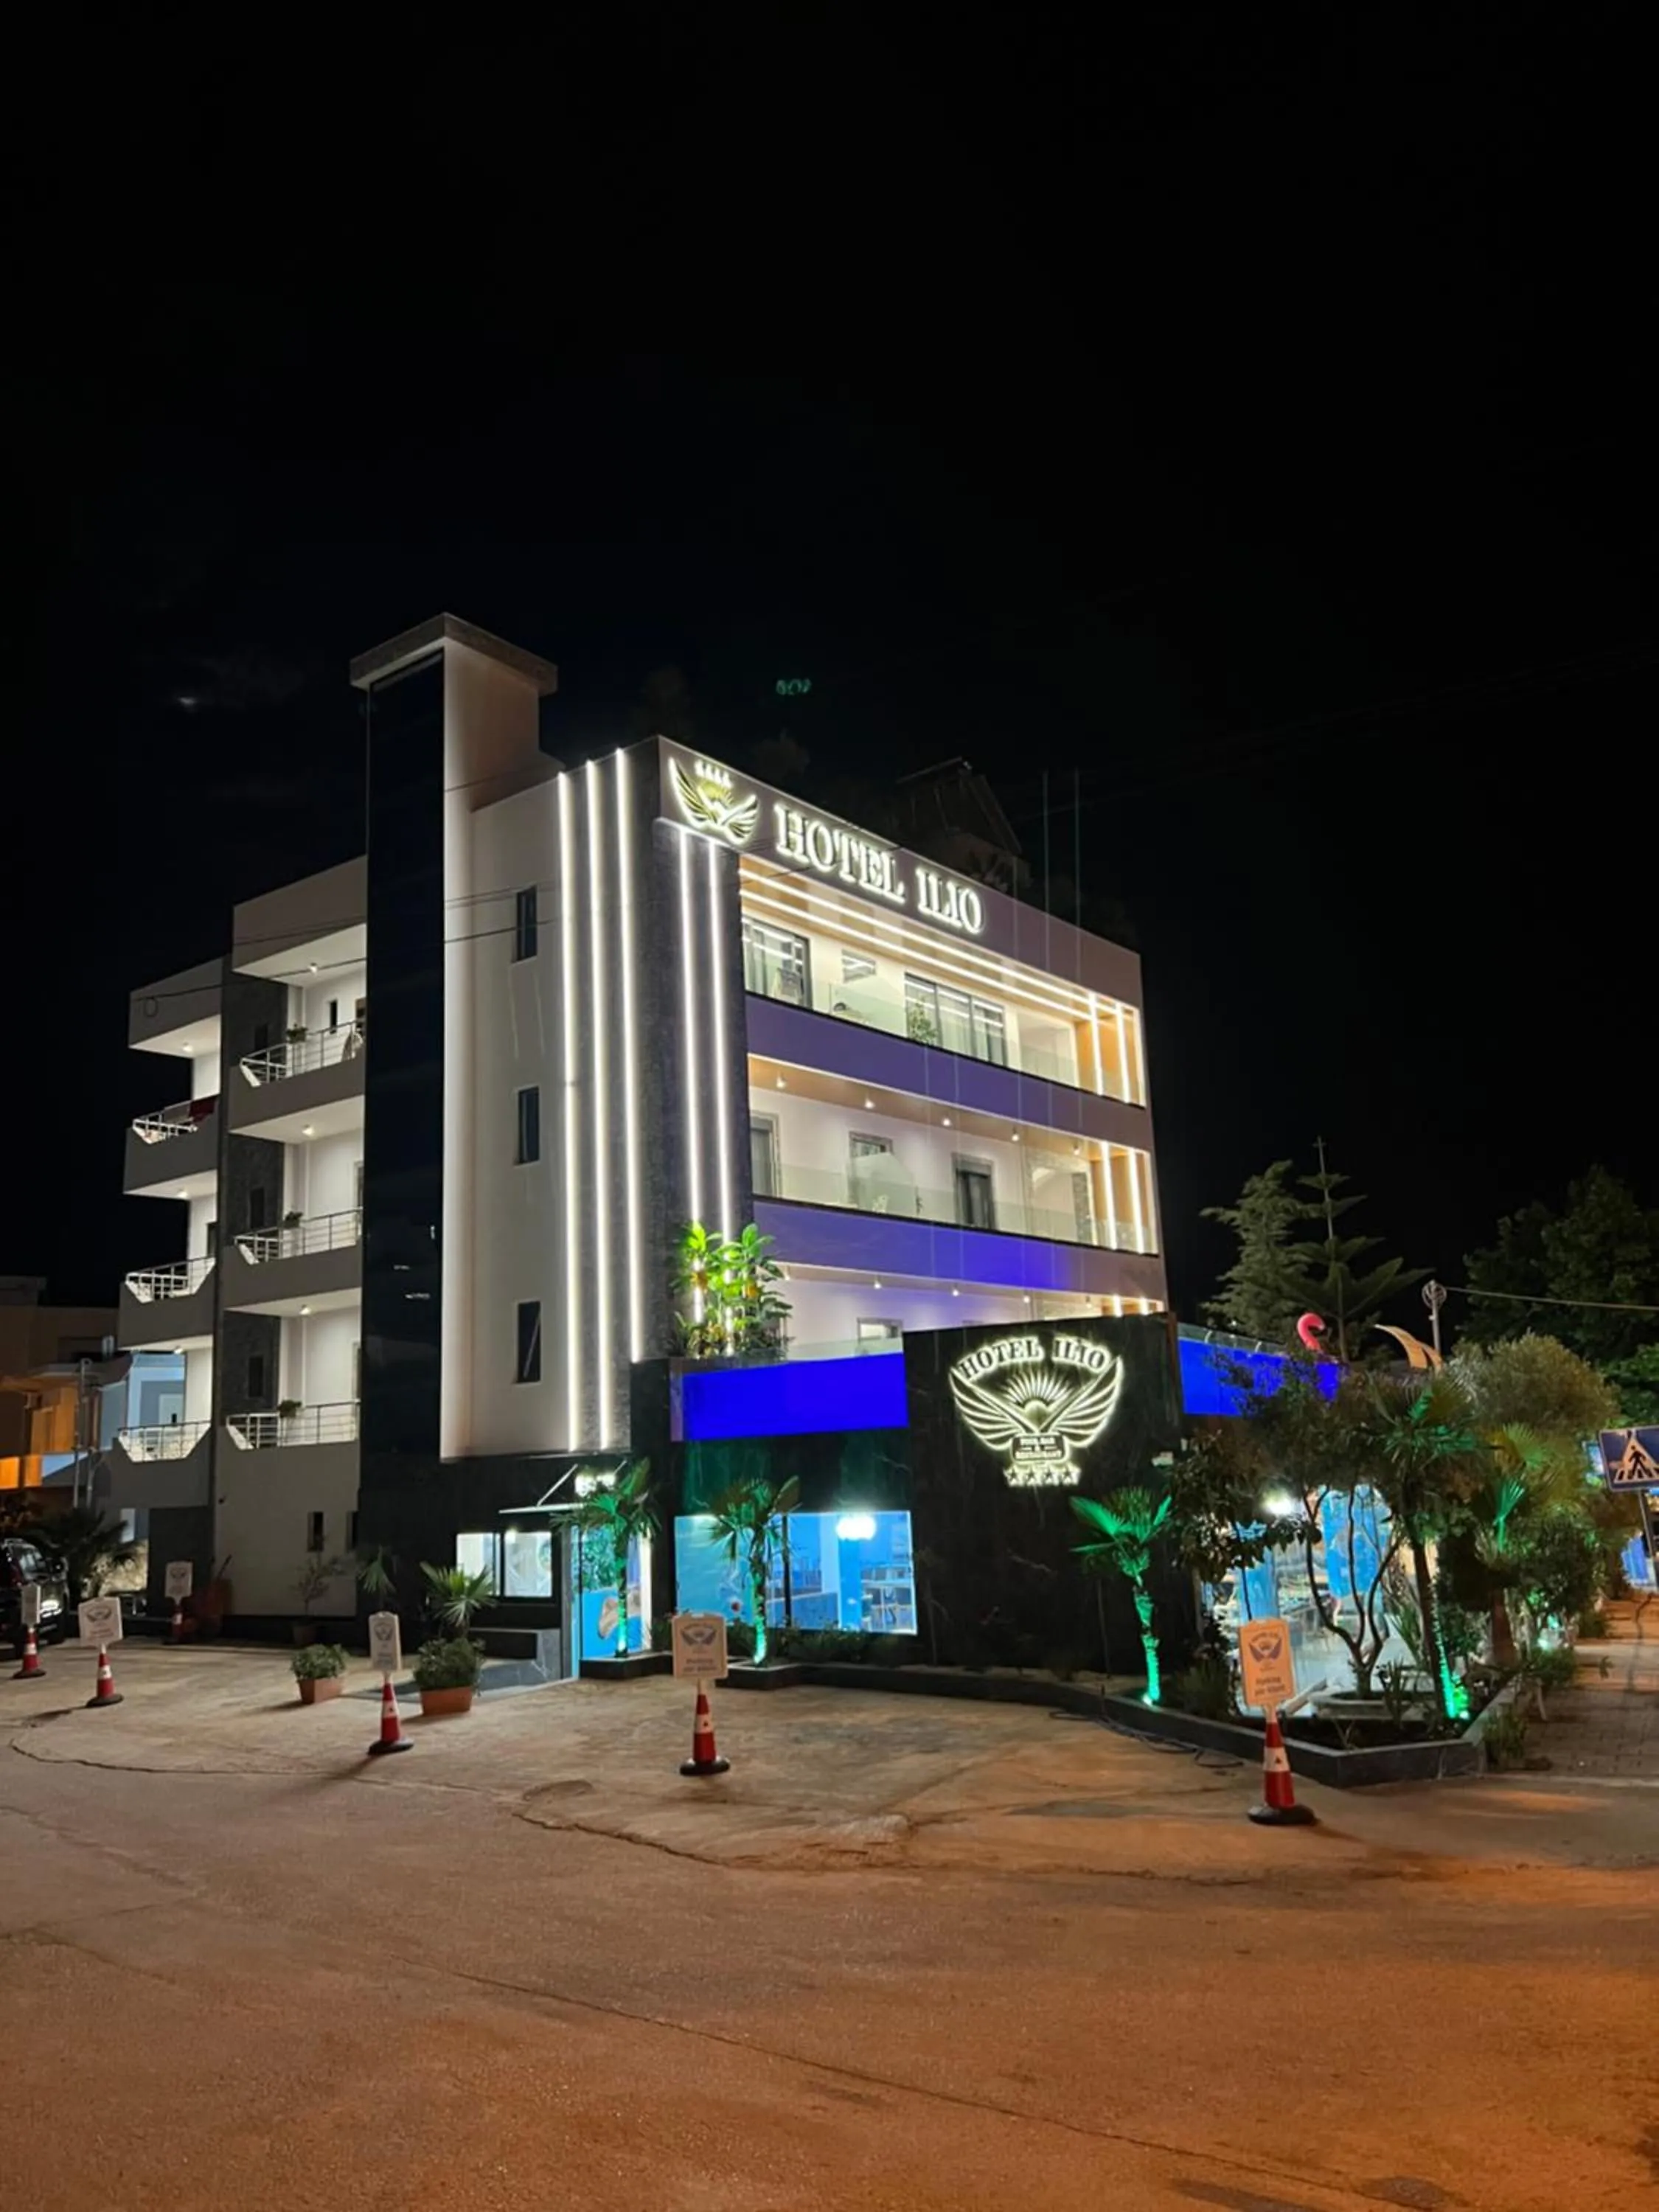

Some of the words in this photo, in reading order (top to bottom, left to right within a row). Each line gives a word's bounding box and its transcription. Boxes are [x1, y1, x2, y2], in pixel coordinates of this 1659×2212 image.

[775, 804, 905, 903] HOTEL
[917, 868, 984, 934] ILIO
[959, 1337, 1044, 1381] HOTEL
[1051, 1337, 1110, 1374] ILIO
